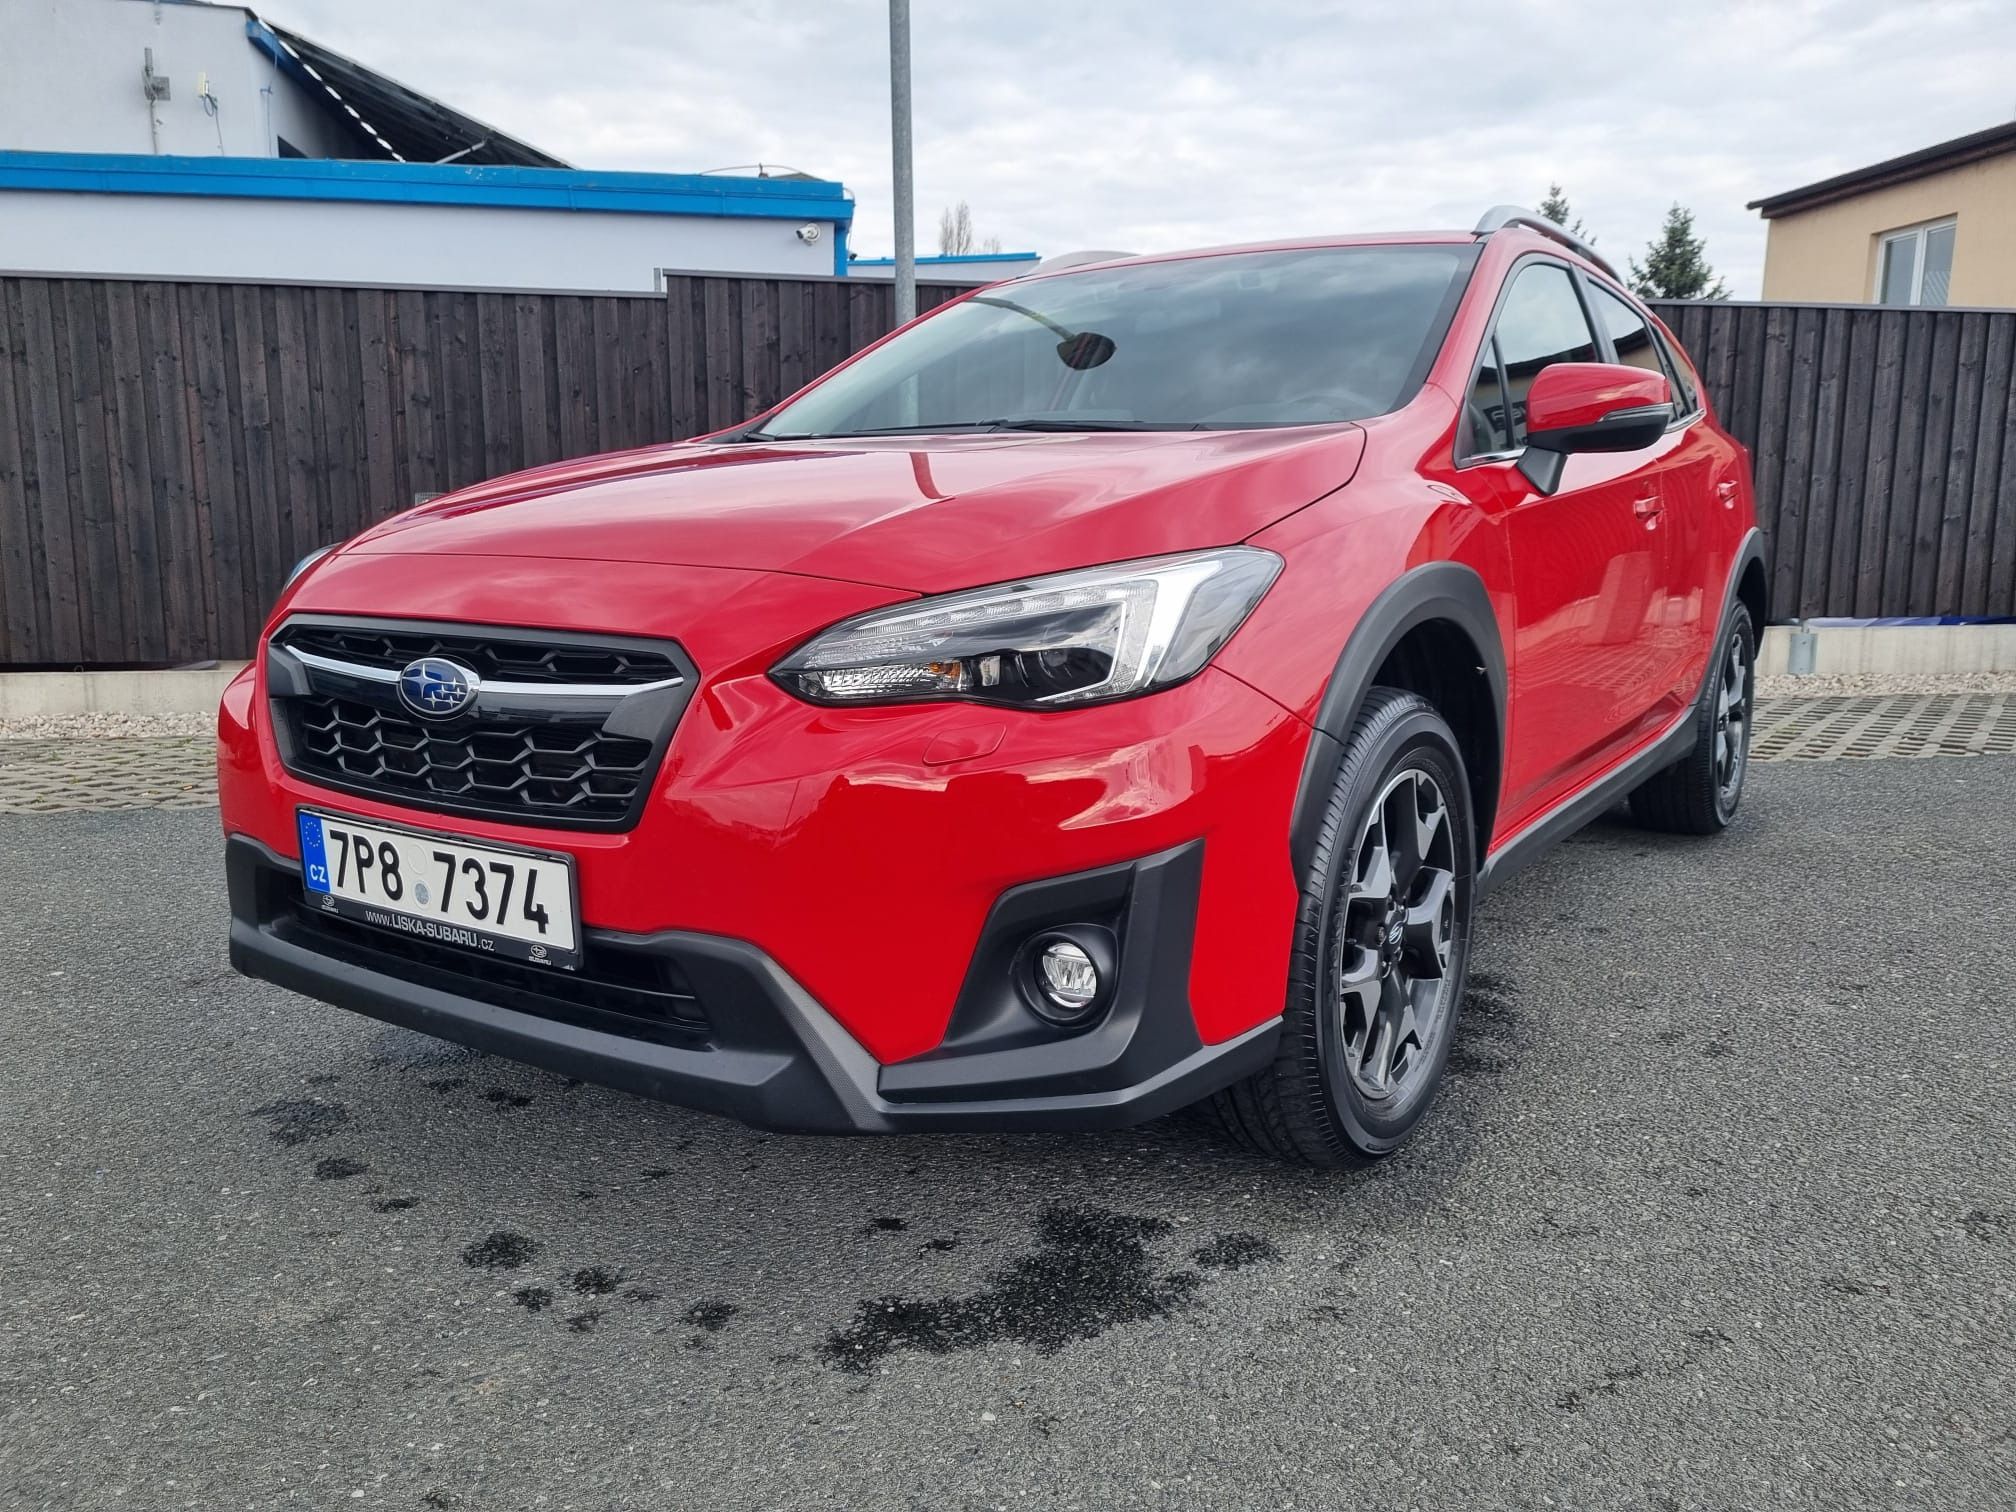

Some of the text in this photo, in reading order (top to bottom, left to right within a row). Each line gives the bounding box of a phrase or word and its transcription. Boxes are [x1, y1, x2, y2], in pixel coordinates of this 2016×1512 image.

[309, 864, 327, 883] CZ
[329, 829, 549, 934] 7P8 7374
